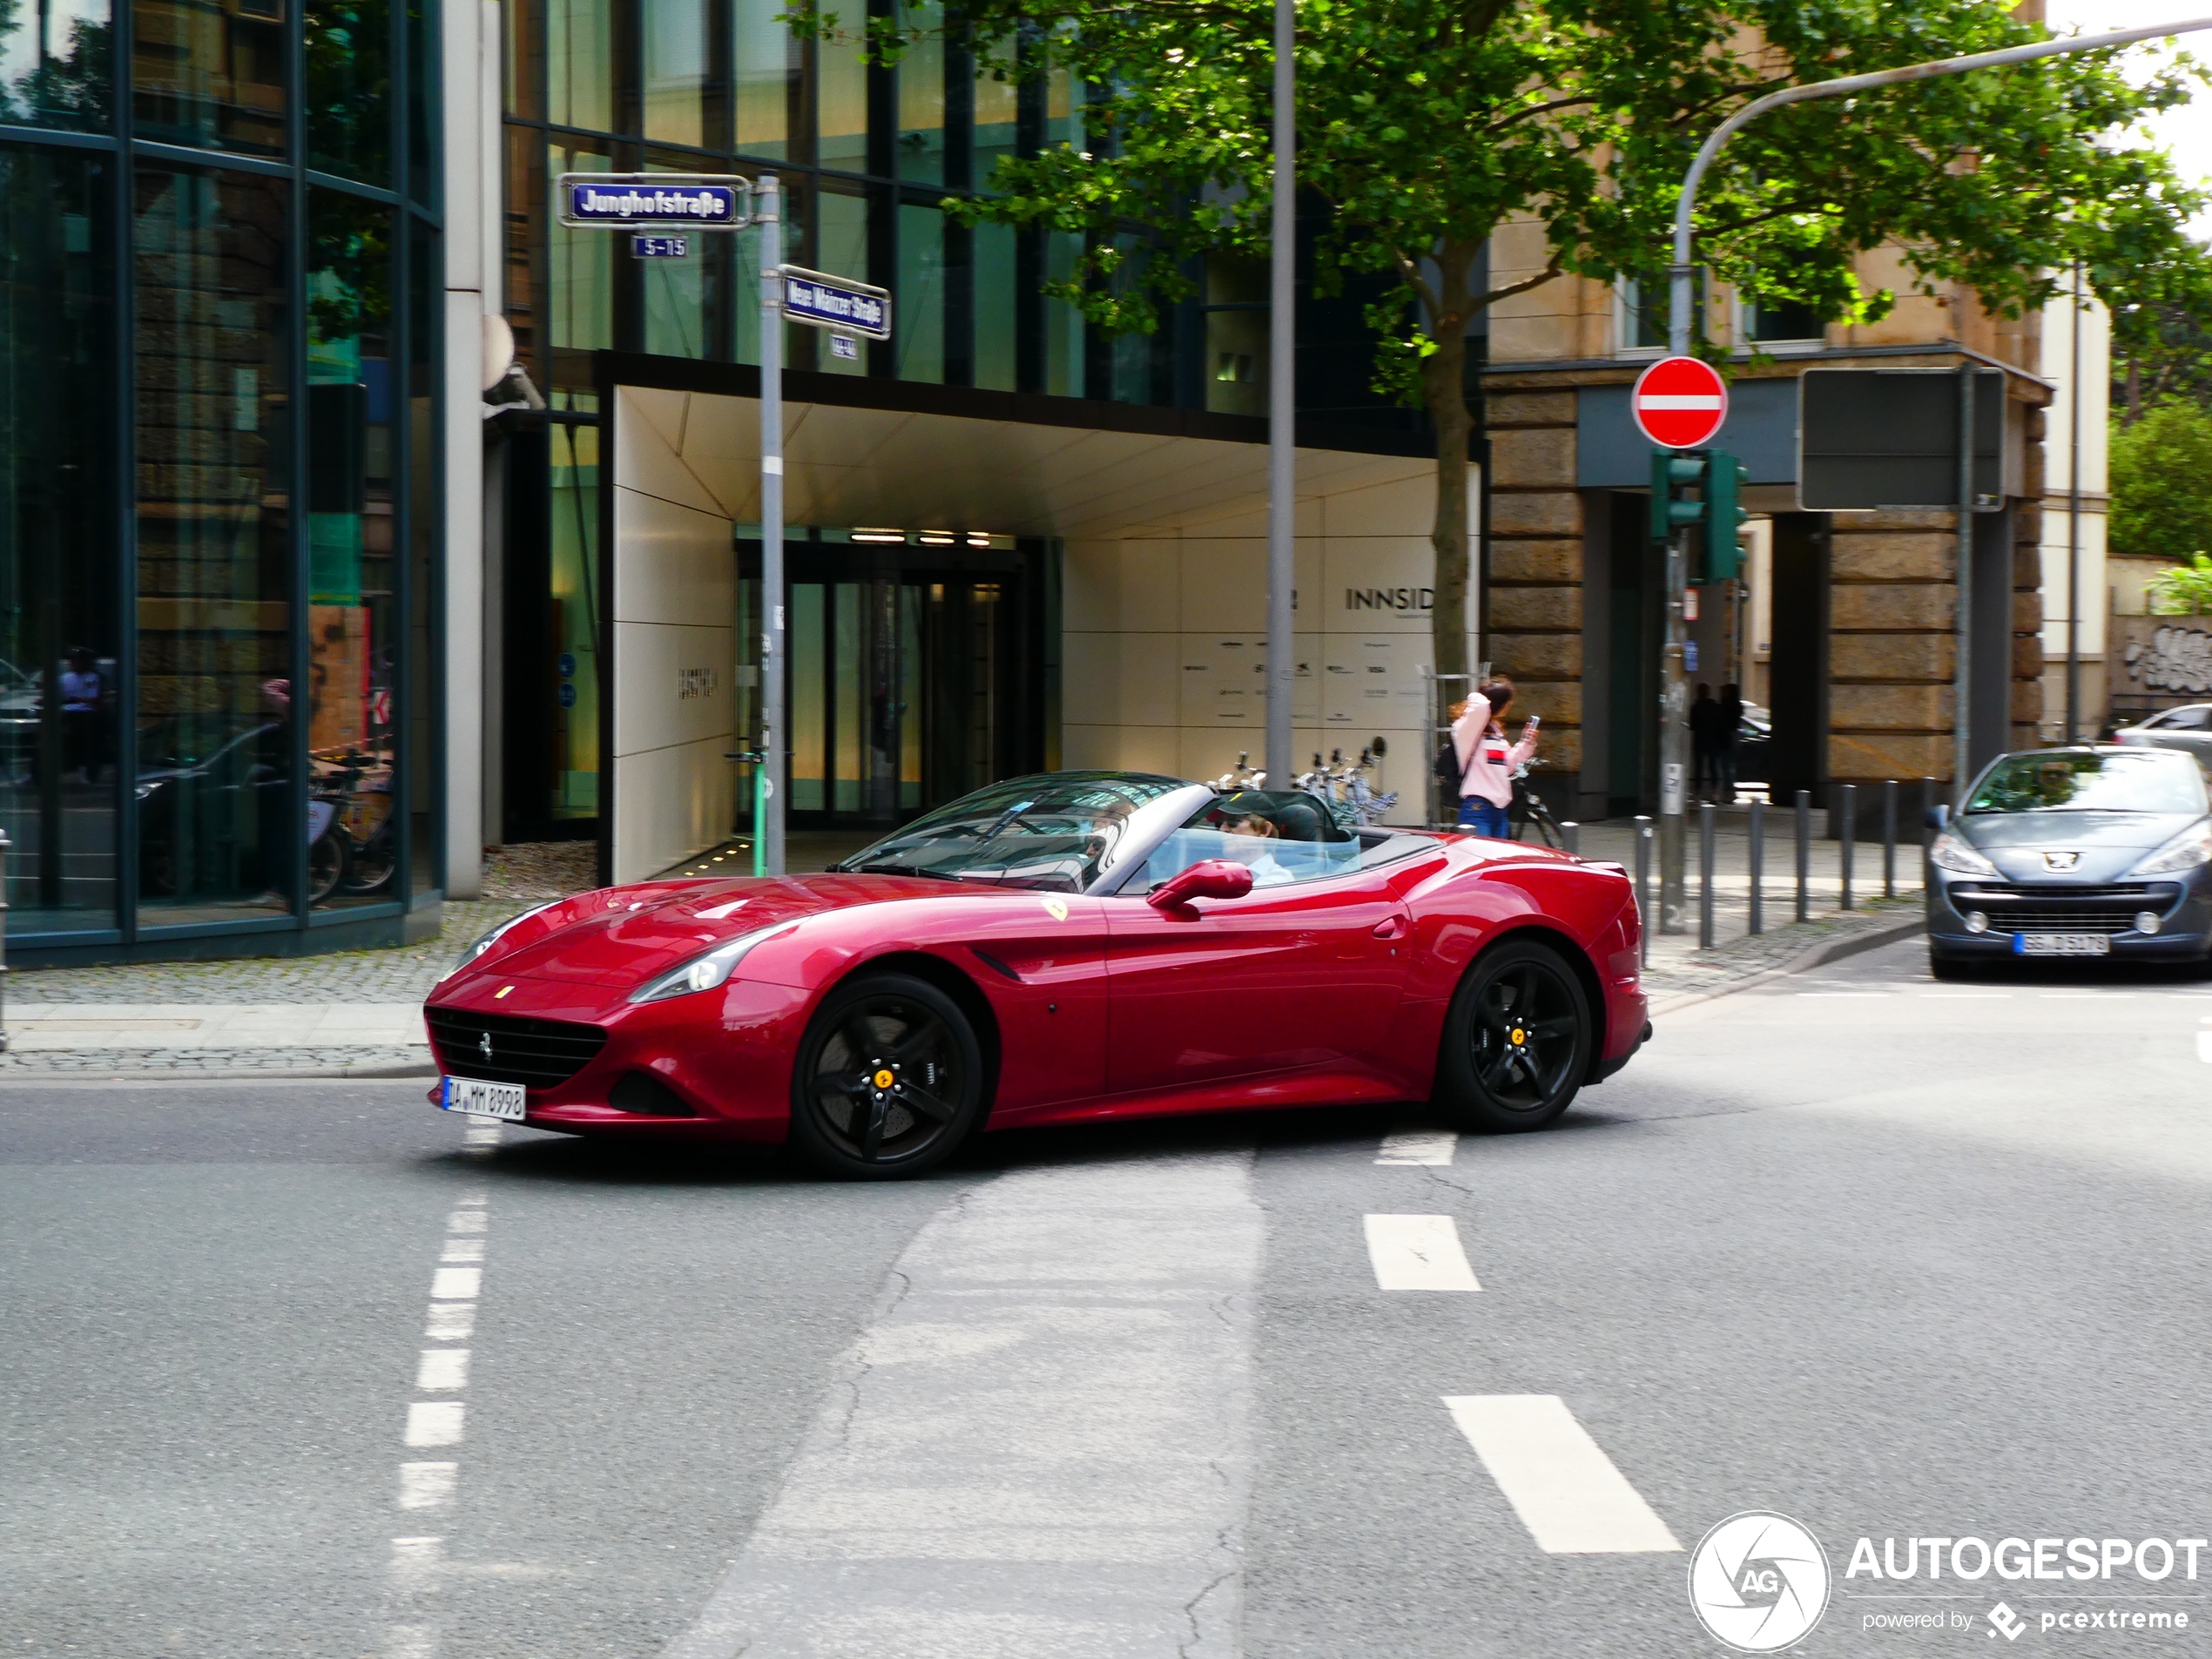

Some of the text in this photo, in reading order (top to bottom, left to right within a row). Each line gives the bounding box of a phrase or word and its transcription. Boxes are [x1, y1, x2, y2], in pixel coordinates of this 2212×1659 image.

[581, 189, 725, 218] Junghofstraße
[644, 239, 685, 256] 5-15
[489, 1087, 523, 1116] 8998
